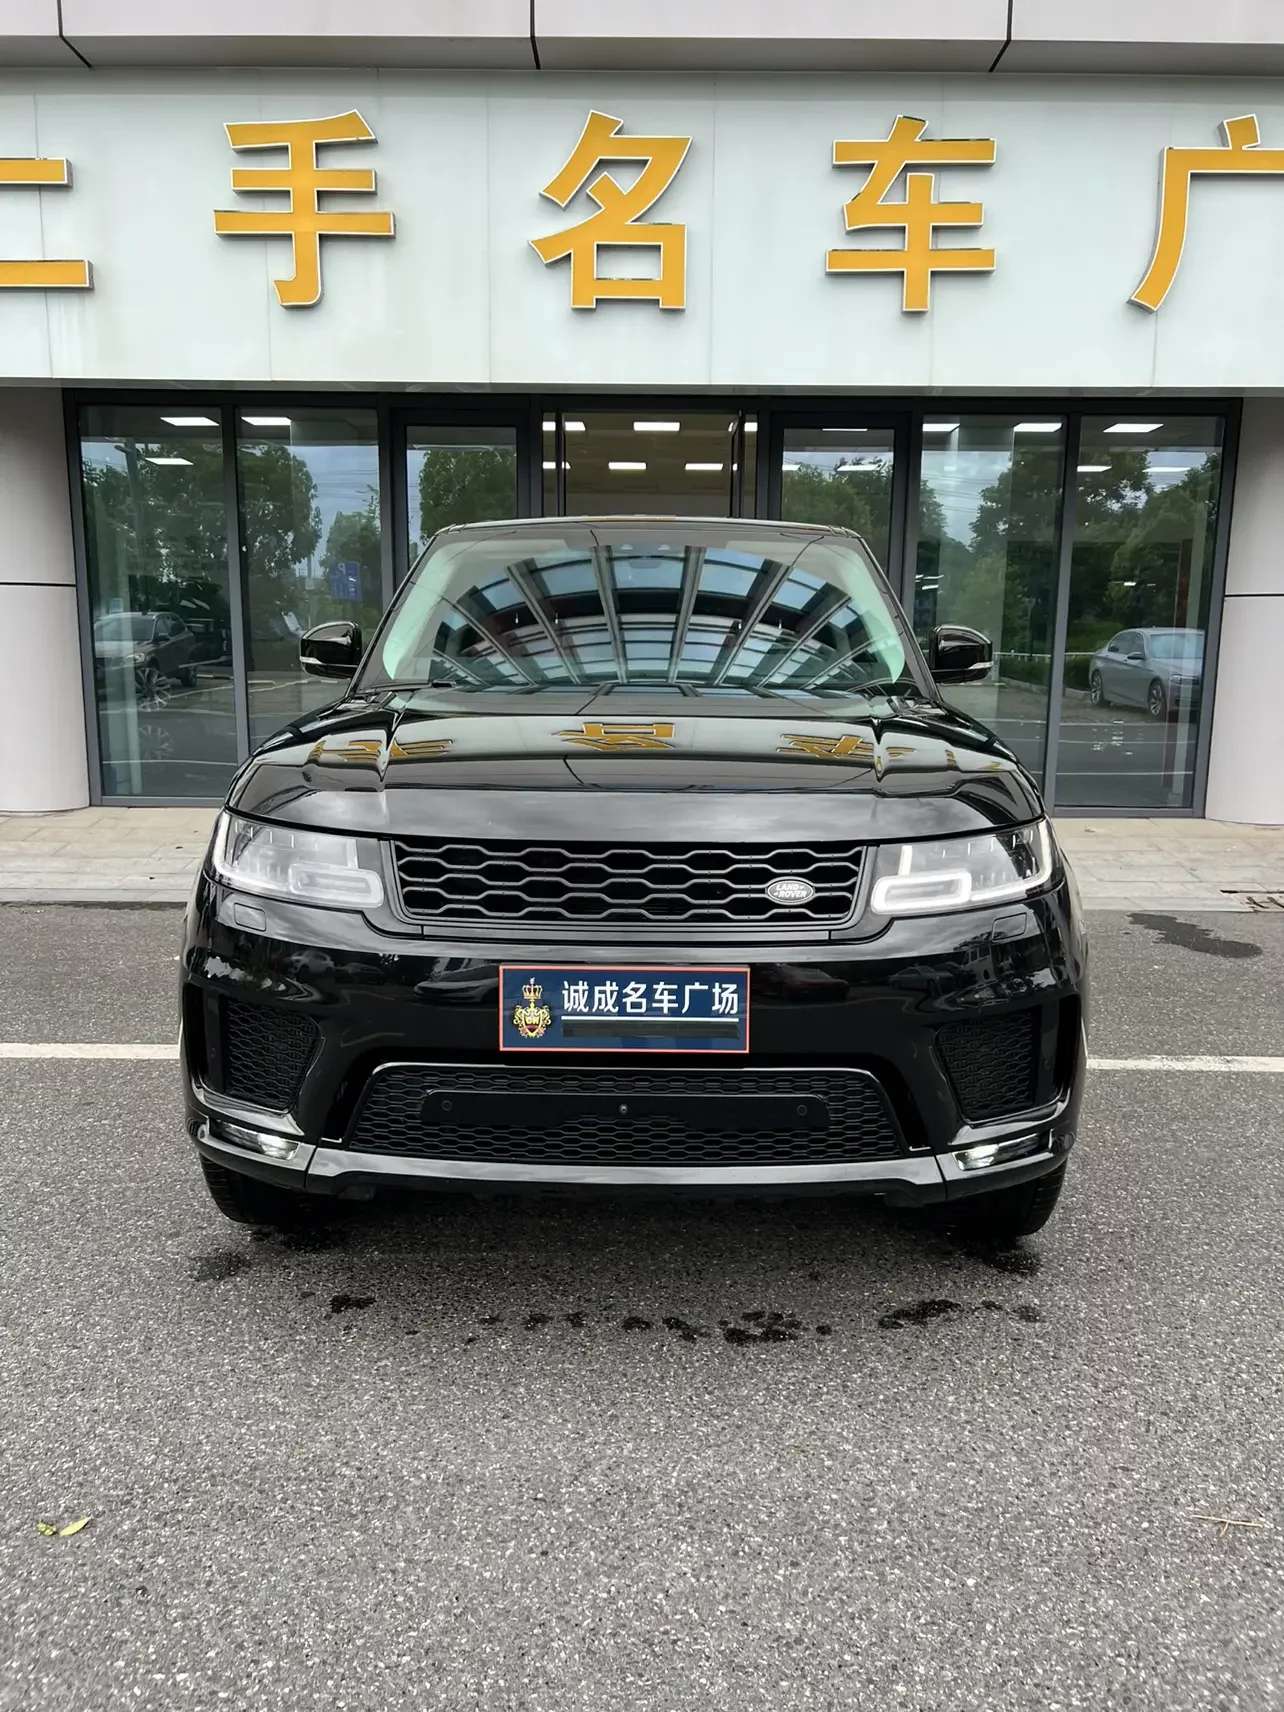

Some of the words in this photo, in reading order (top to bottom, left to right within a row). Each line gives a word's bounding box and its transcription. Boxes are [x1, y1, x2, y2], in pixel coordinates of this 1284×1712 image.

[776, 883, 799, 891] LAND
[778, 890, 808, 898] ROVER
[561, 979, 739, 1015] 诚成名车广场
